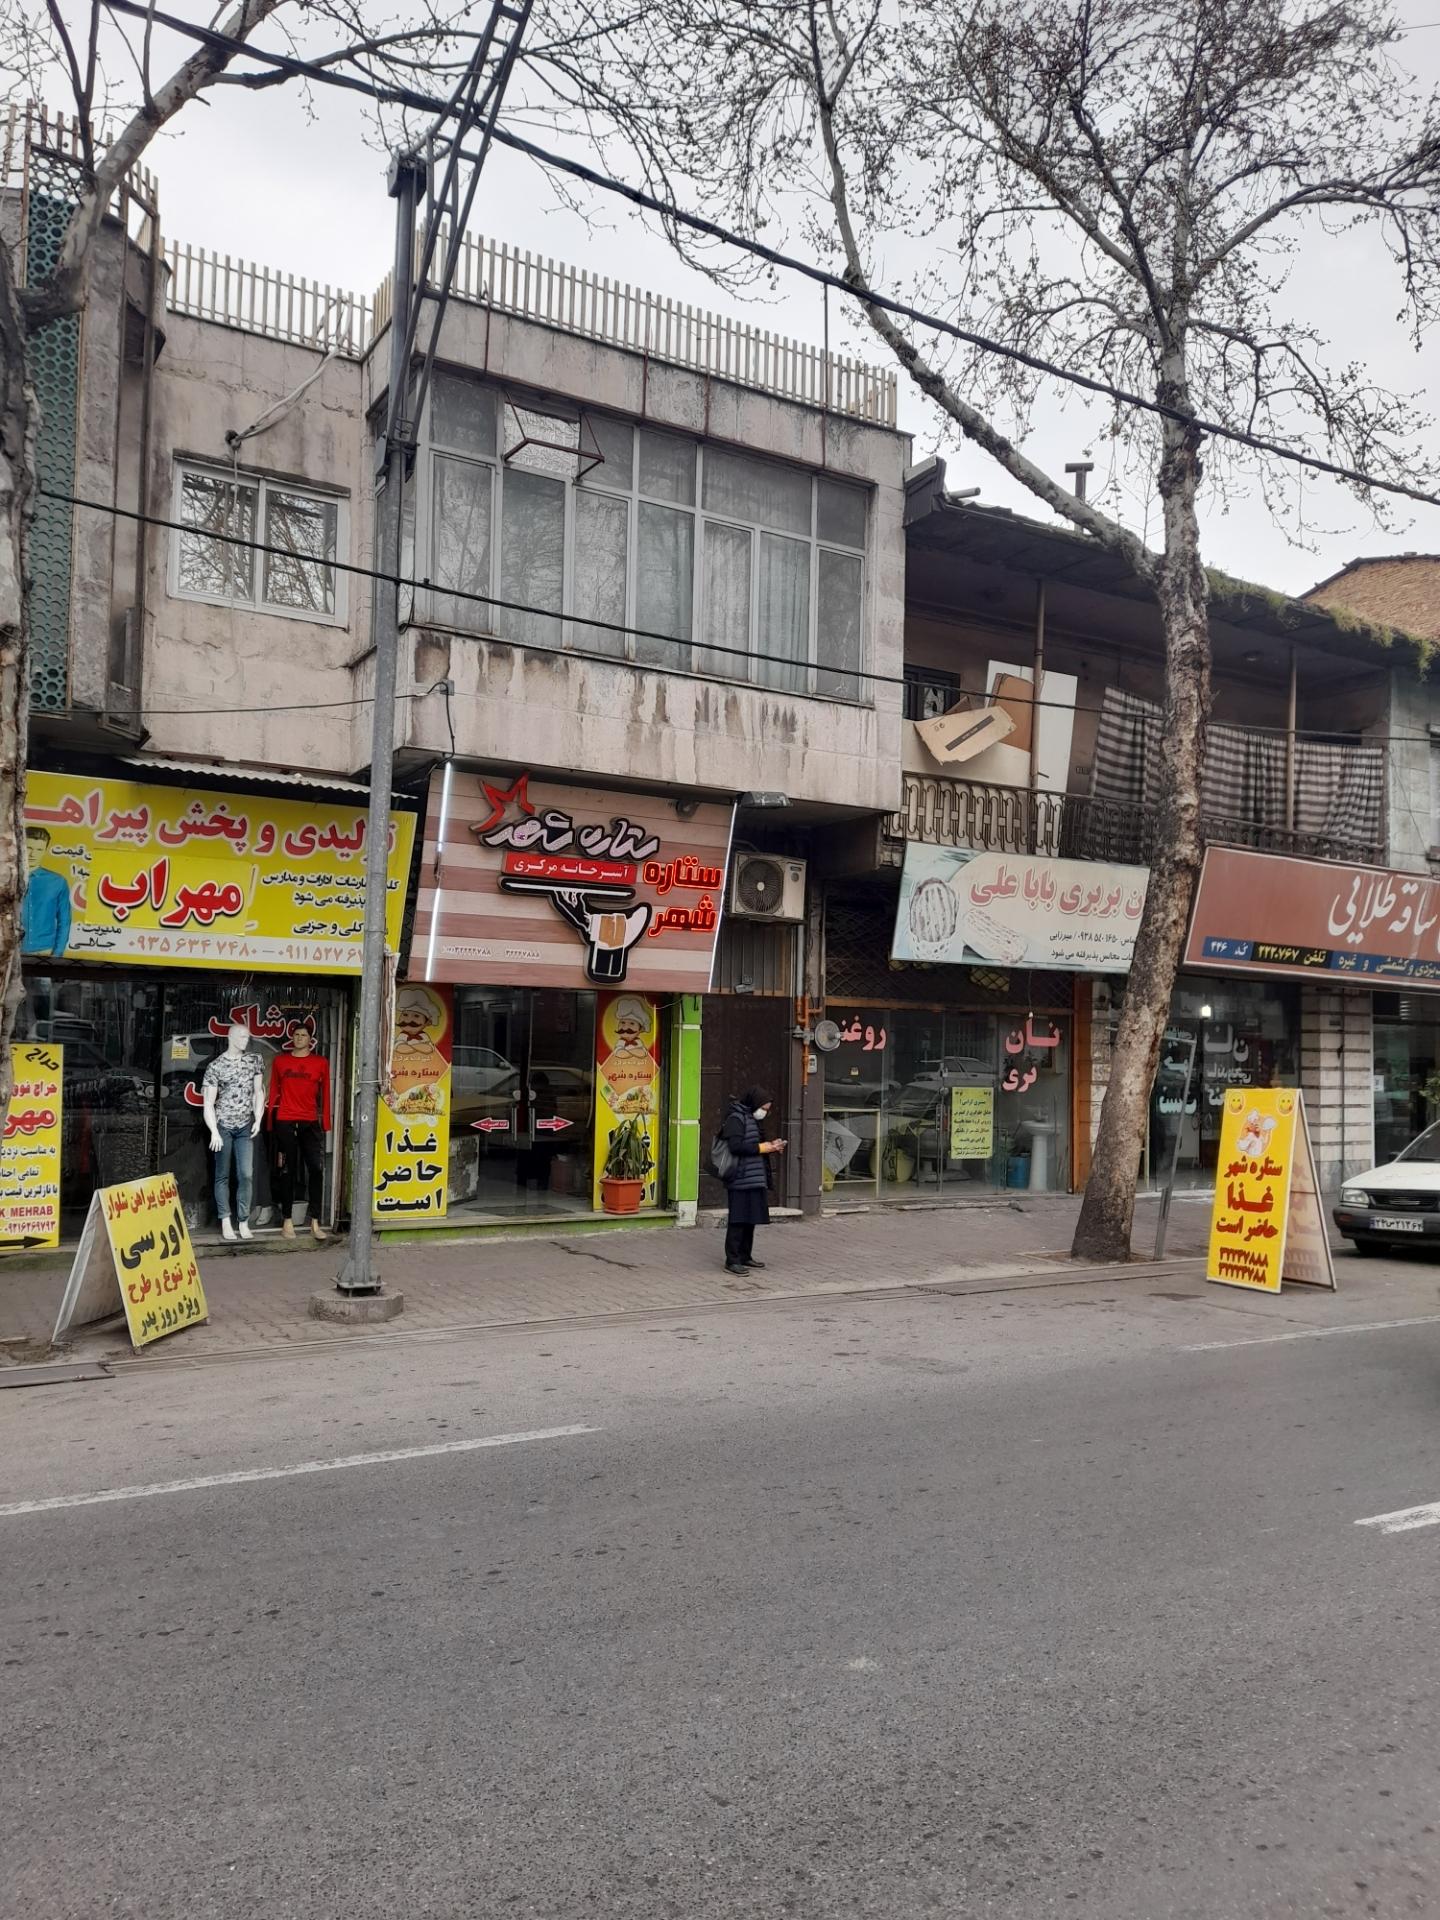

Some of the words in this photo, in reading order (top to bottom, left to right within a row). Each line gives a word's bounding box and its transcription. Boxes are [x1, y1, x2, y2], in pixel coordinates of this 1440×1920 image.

[24, 790, 150, 844] پیراه
[158, 802, 248, 852] پخش
[255, 823, 276, 853] و
[284, 817, 396, 862] تلیدی
[579, 816, 661, 861] ستاره
[643, 855, 723, 895] ستاره
[969, 864, 1018, 904] علی
[1023, 866, 1056, 911] بابا
[99, 856, 244, 928] مهراب
[294, 891, 314, 907] شود
[1059, 882, 1122, 916] بربری
[648, 894, 718, 938] شهر
[1327, 875, 1397, 945] طلایی
[1387, 880, 1438, 936] ساقه
[1303, 950, 1326, 965] تلفن
[840, 1015, 886, 1051] روغن
[1006, 1018, 1060, 1054] نان
[25, 1048, 59, 1071] حراج
[3, 1108, 57, 1138] مهر
[386, 1128, 437, 1153] غذا
[374, 1159, 443, 1192] حاضر
[1223, 1155, 1248, 1178] شهر
[1249, 1156, 1283, 1181] ستاره
[107, 1191, 129, 1221] شلوار
[130, 1187, 156, 1214] پیراهن
[376, 1188, 443, 1212] است
[1227, 1182, 1274, 1213] غذا
[1216, 1215, 1244, 1234] است
[1244, 1219, 1279, 1241] حاضر
[128, 1273, 152, 1305] طرح
[163, 1262, 183, 1293] تنوع
[159, 1306, 177, 1330] روز
[177, 1295, 201, 1320] ویژه
[141, 1310, 157, 1338] پدر
